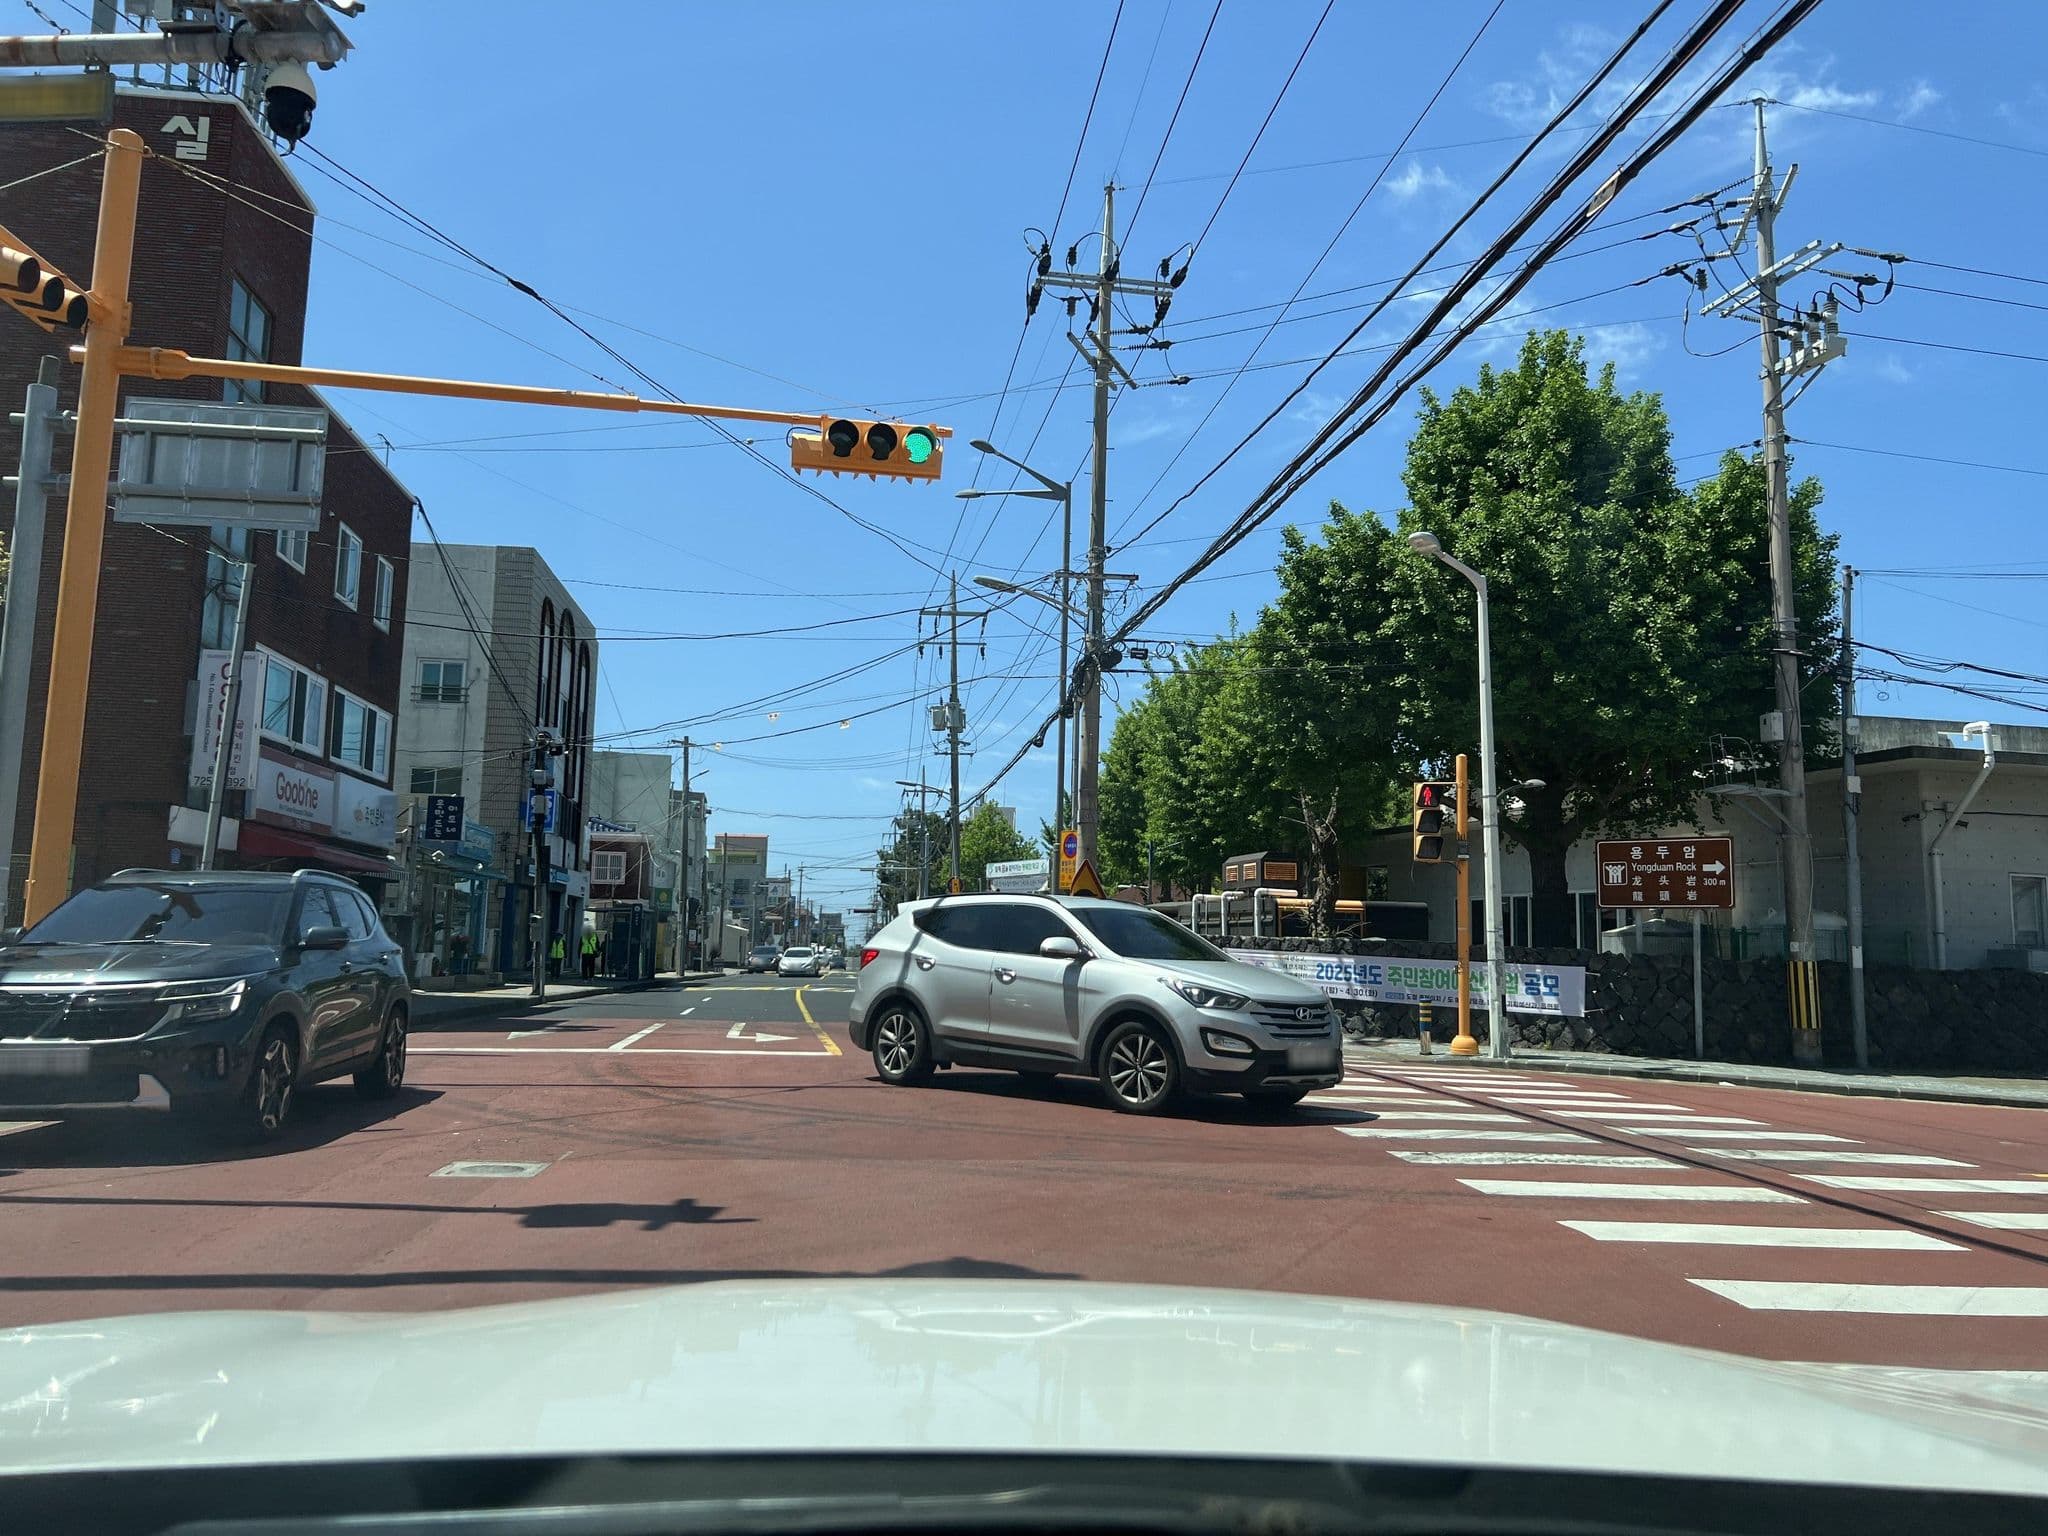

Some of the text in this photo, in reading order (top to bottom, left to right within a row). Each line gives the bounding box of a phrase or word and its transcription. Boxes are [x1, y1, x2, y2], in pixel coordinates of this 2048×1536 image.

[1631, 862, 1697, 873] Yongduam Rock
[1703, 877, 1726, 886] 300 m
[1316, 962, 1382, 985] 2025년도
[1387, 965, 1518, 995] 주민참여산업
[1524, 973, 1560, 997] 공모
